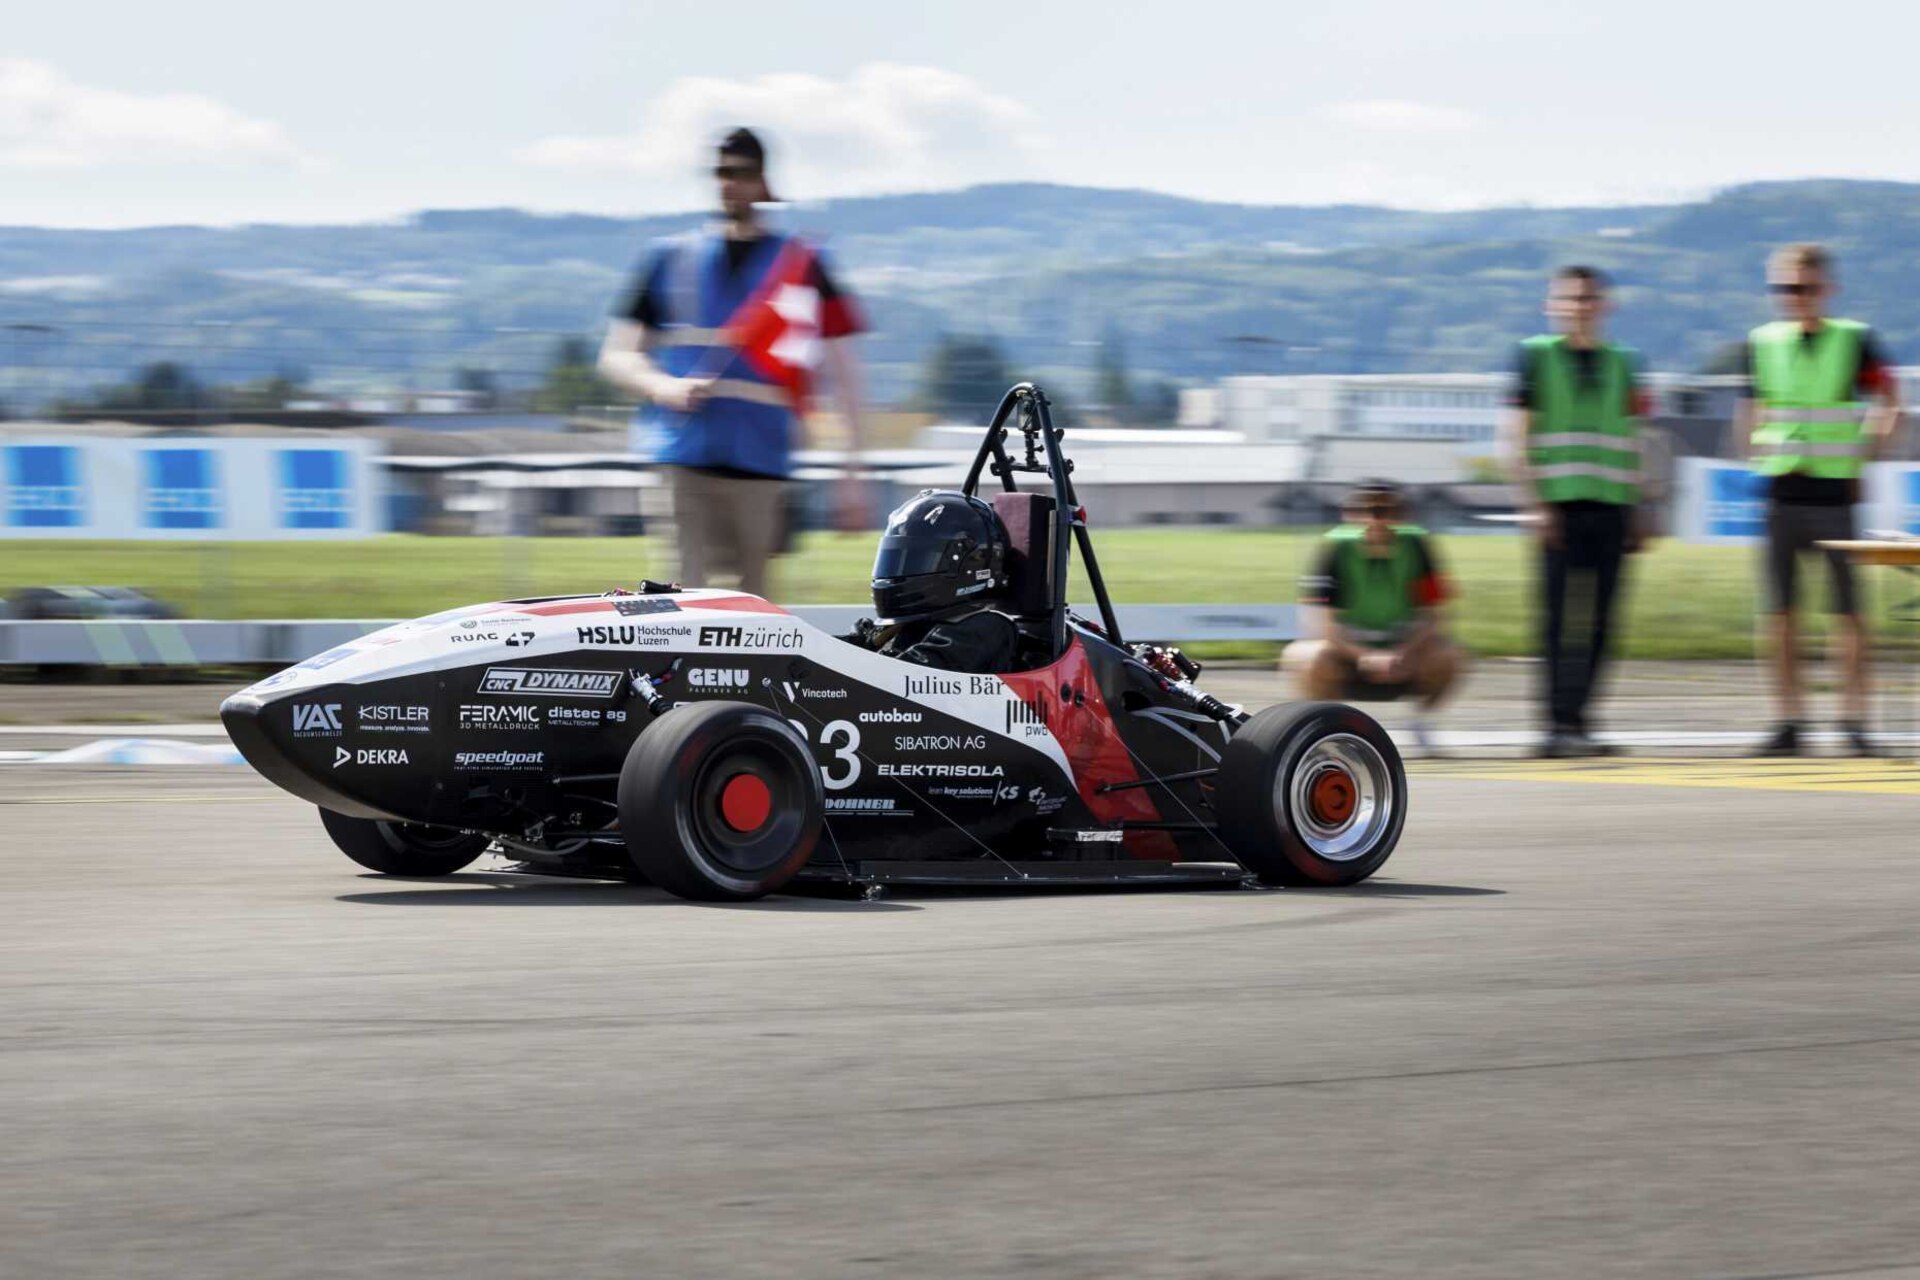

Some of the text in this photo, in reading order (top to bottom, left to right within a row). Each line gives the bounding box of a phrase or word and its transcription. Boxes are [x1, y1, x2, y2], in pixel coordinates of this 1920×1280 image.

[451, 632, 499, 643] RUAG
[577, 625, 635, 645] HSLU
[637, 625, 692, 636] Hochschule
[698, 626, 804, 649] ETH zürich
[637, 636, 670, 646] Luzern
[486, 671, 617, 691] CNC DYNAMIX
[687, 667, 750, 688] GENU
[802, 687, 848, 699] Vincotech
[904, 674, 1006, 699] Julius Bär
[293, 703, 343, 731] VAC
[358, 705, 430, 721] KISTLER
[459, 704, 541, 723] FERAMIC
[548, 705, 627, 722] distec ag
[858, 707, 922, 723] autobau
[459, 722, 541, 731] 3D METALLDRUCK
[894, 734, 986, 751] SIBATRON AG
[356, 749, 409, 765] DEKRA
[454, 750, 545, 766] speedgoat
[787, 719, 862, 790] 3
[877, 764, 1005, 777] ELEKTRISOLA
